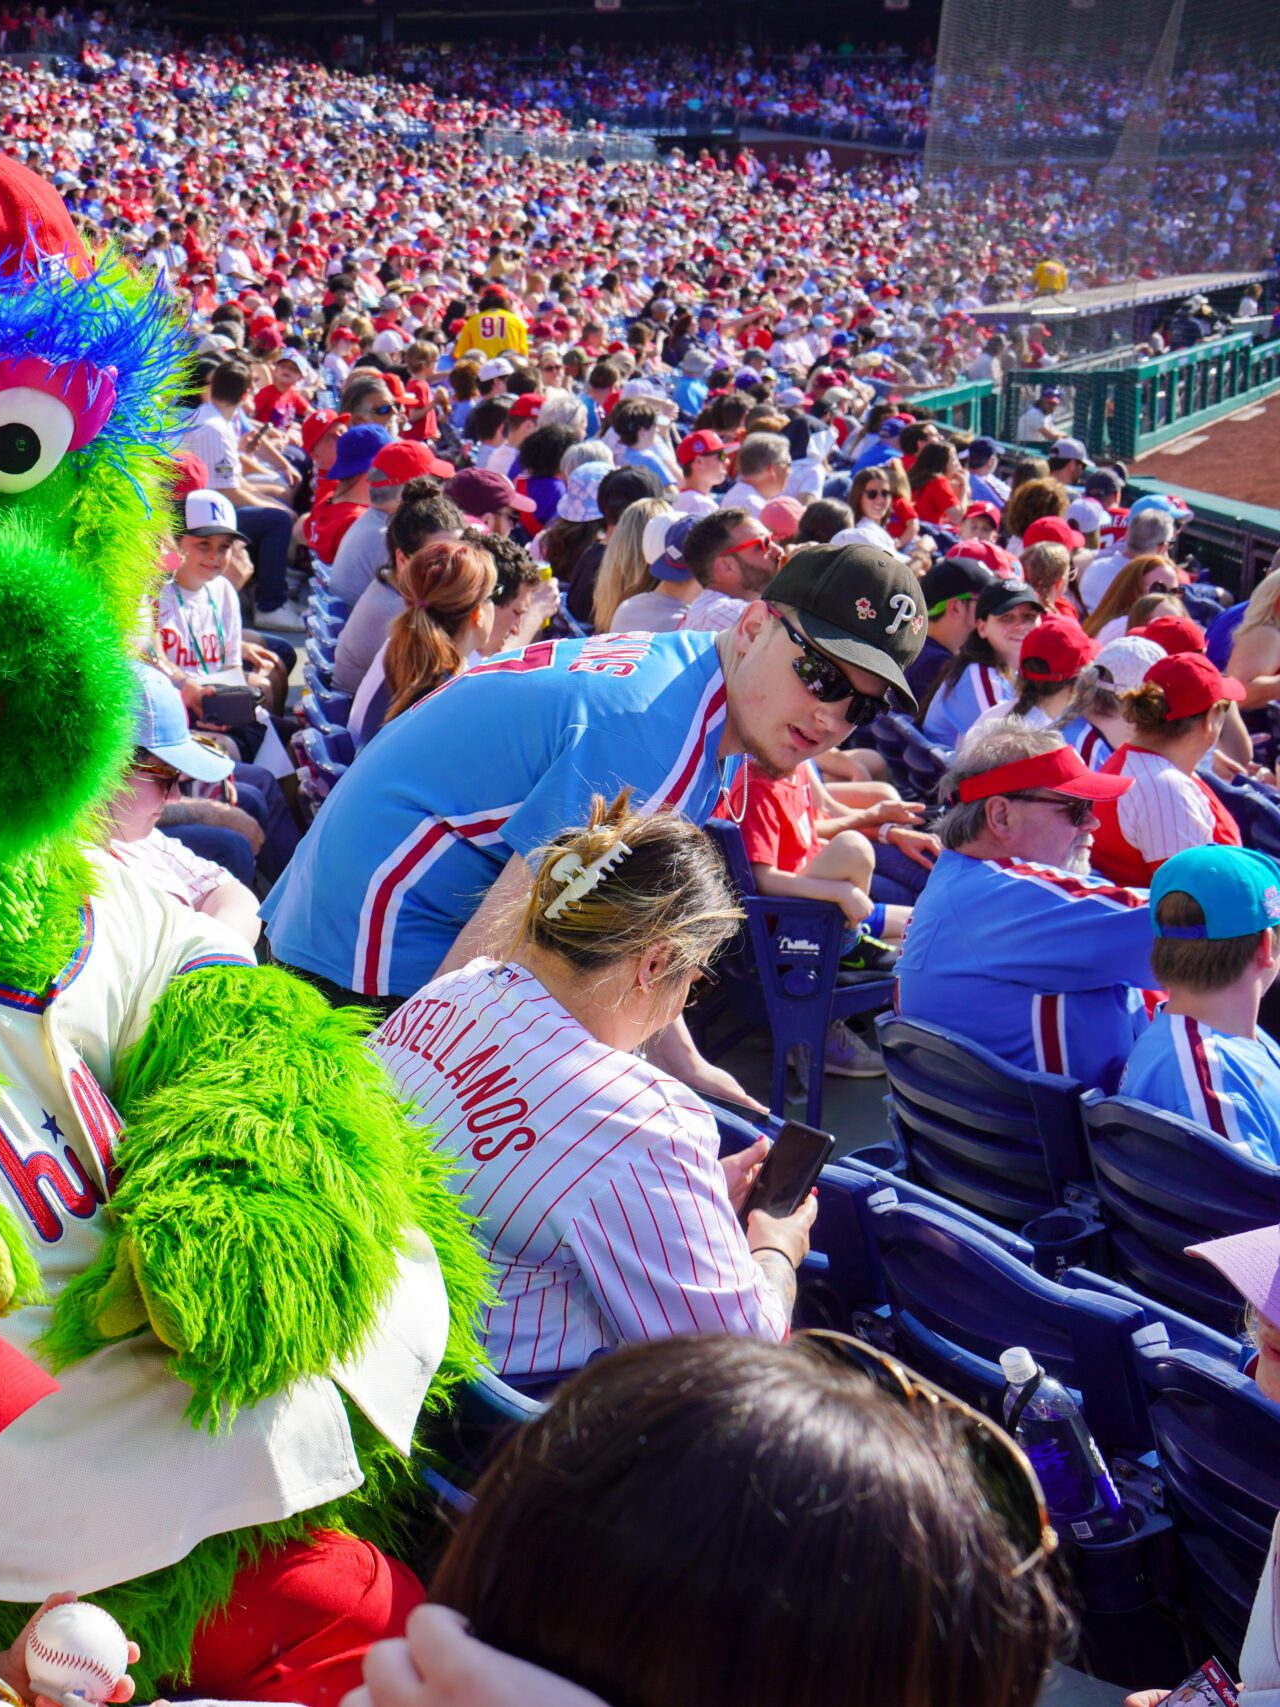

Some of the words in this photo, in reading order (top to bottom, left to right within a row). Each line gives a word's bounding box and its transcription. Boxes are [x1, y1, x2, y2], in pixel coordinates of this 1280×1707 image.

[480, 315, 506, 339] 91
[209, 502, 225, 522] N
[884, 593, 917, 635] P
[374, 999, 537, 1163] ASTELLANOS
